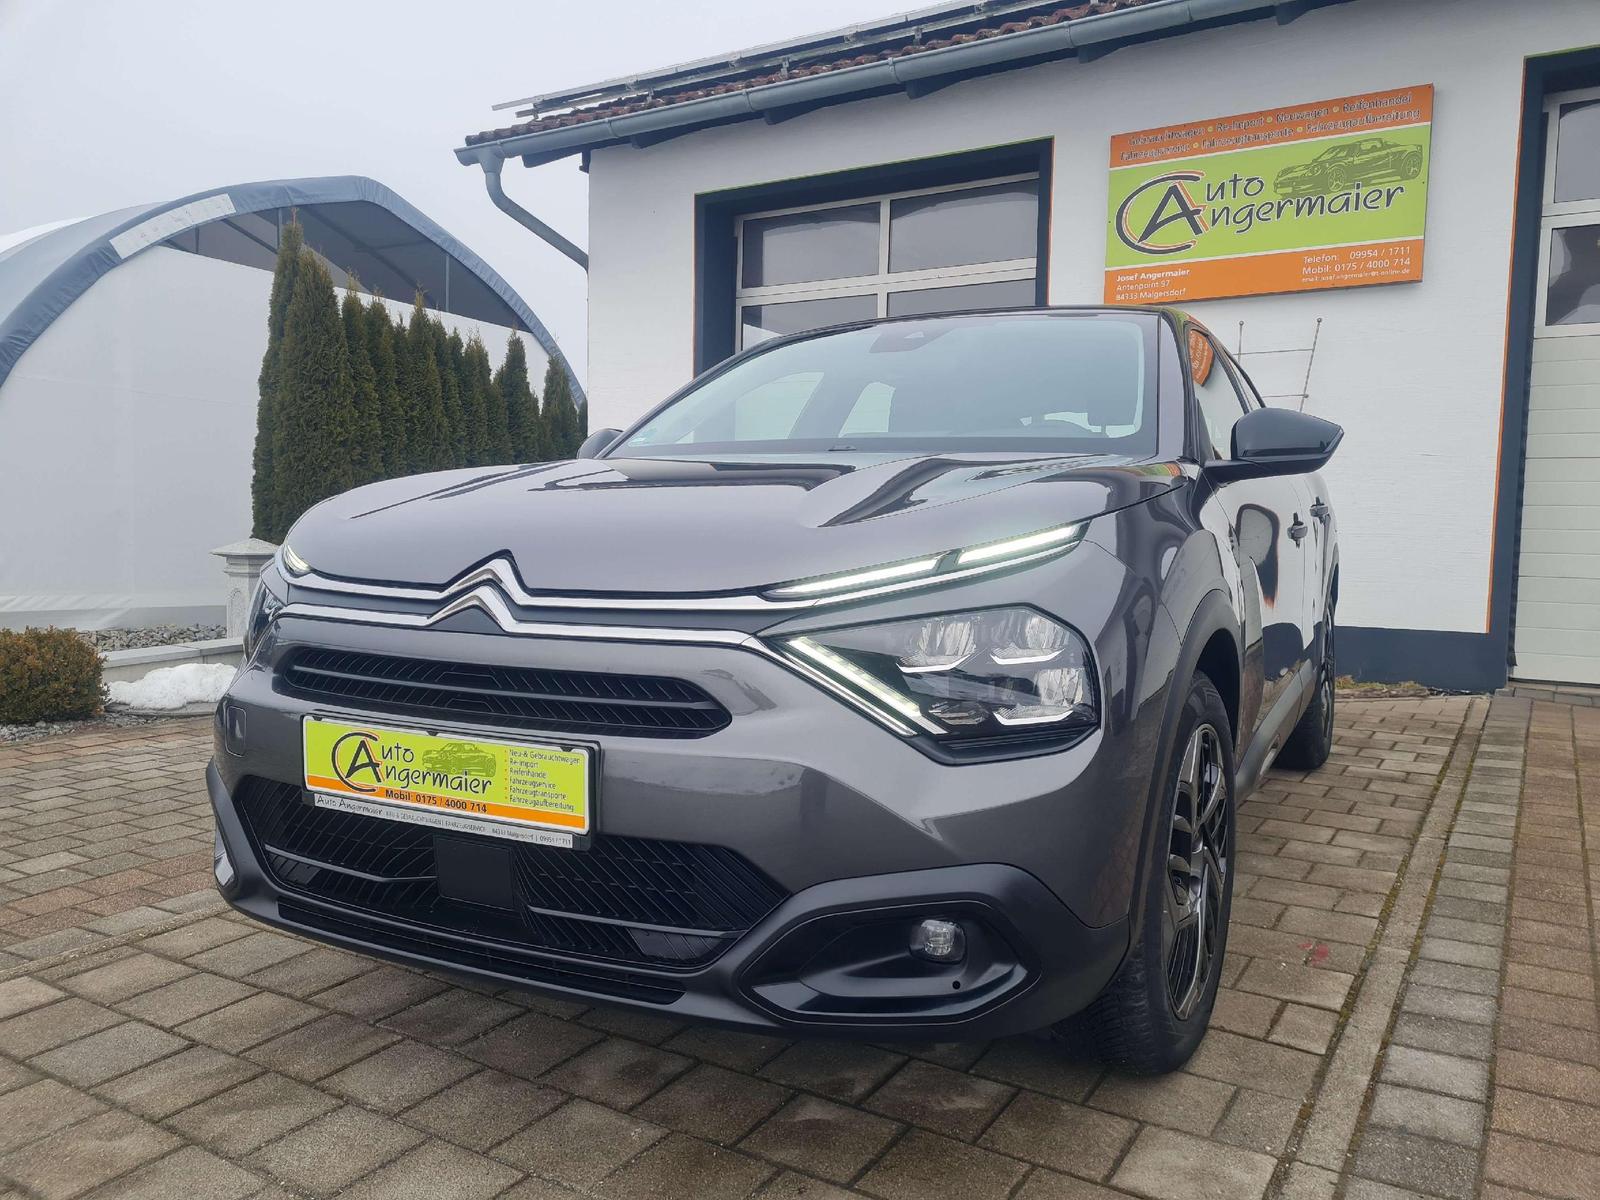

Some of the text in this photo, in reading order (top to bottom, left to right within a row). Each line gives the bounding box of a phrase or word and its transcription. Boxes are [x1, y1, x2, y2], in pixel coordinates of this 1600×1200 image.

[1276, 107, 1329, 124] Neuwagen
[1343, 94, 1412, 112] Reifenhandel
[1349, 249, 1378, 260] 09954
[1389, 246, 1410, 256] 1711
[1116, 268, 1190, 282] Josef Angermaier
[1302, 264, 1332, 275] Mobil:
[1334, 262, 1357, 272] 0175
[1367, 259, 1390, 269] 4000
[1393, 257, 1410, 266] 714
[316, 795, 337, 806] Auto
[339, 798, 383, 815] Angermaier
[385, 789, 413, 801] Mobil:
[415, 794, 437, 806] 0175
[444, 799, 467, 810] 4000
[470, 802, 488, 813] 714
